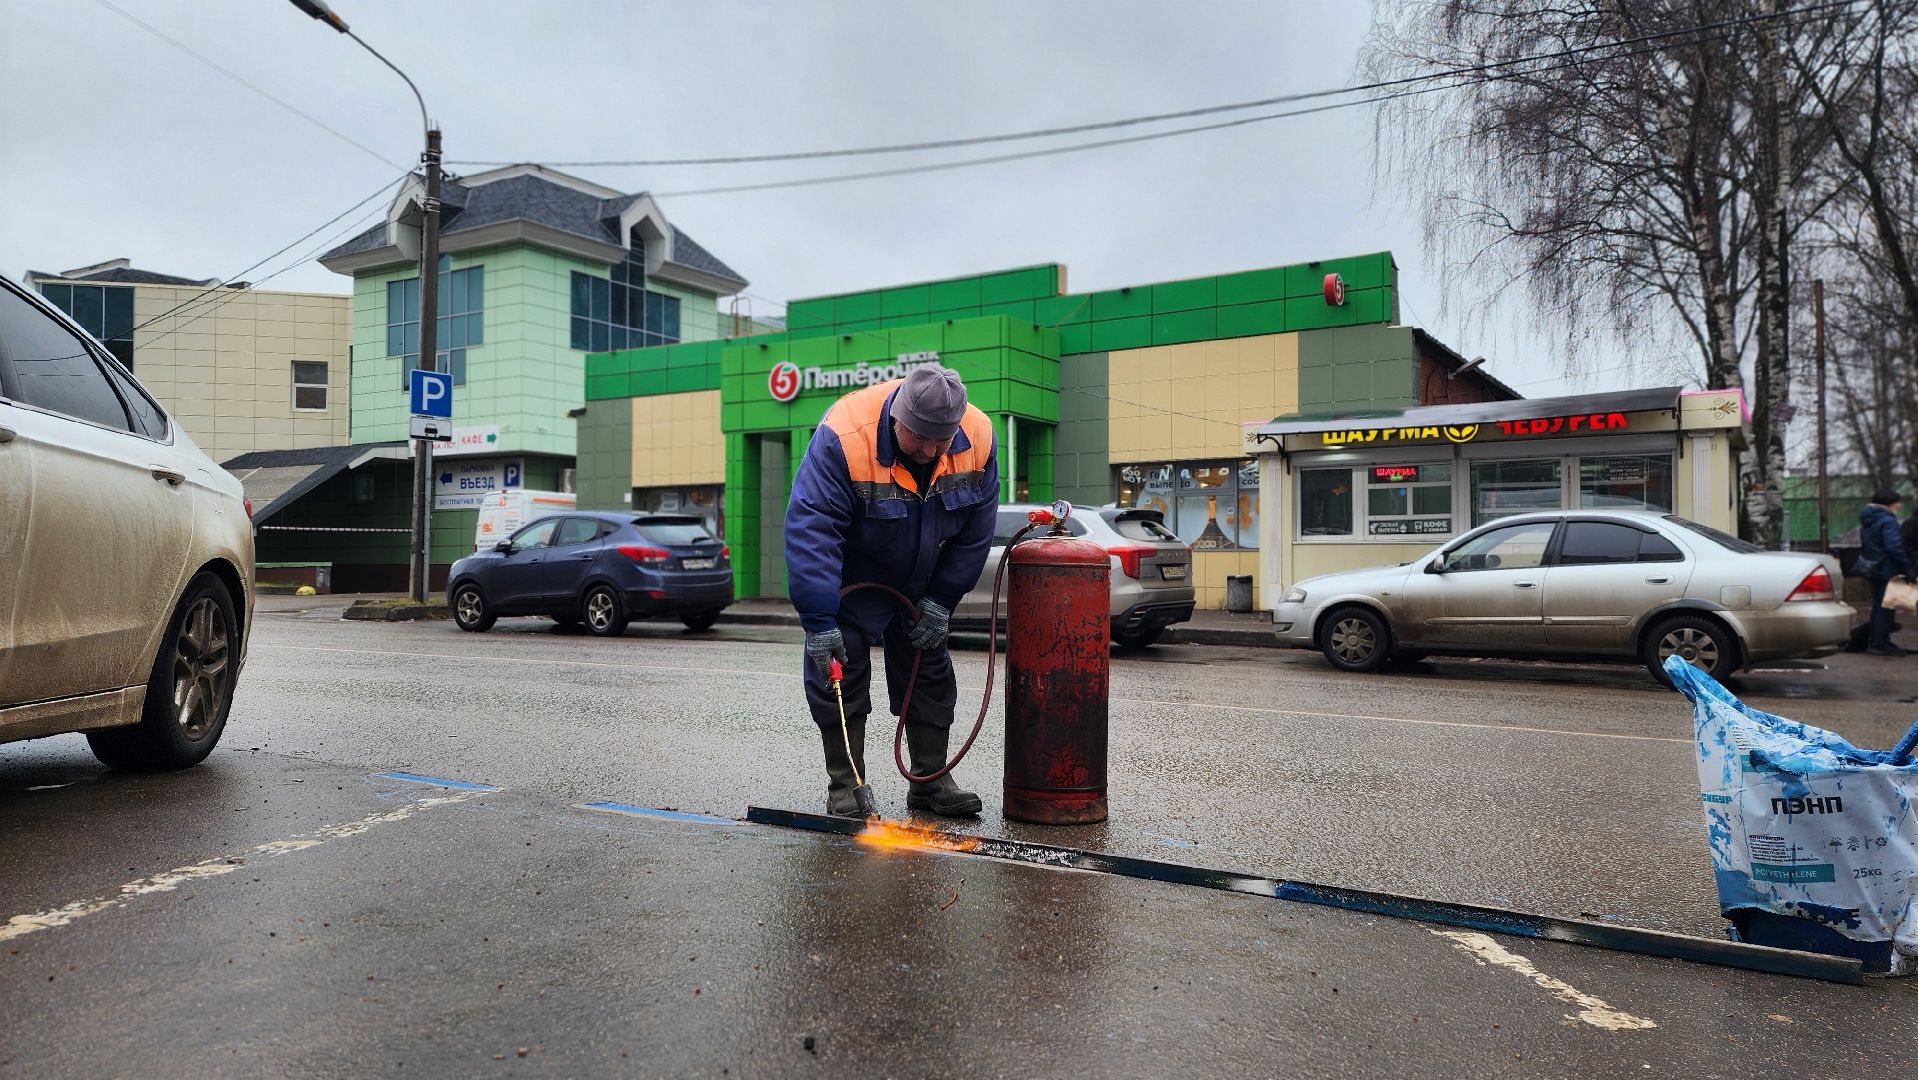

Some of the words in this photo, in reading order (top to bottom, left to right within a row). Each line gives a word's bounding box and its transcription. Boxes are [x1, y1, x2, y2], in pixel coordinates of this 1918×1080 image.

[804, 363, 922, 390] Пятёроч
[422, 375, 445, 411] P
[461, 434, 483, 445] КАФЕ
[460, 463, 495, 473] ПАРКОВКА
[1376, 467, 1417, 476] ШАУРМА
[507, 466, 518, 485] P
[460, 476, 495, 490] ВЪЕЗД
[439, 498, 474, 506] БЕСПЛАТНАЯ
[1423, 520, 1448, 528] КОФЕ
[1701, 793, 1732, 805] СИБУР
[1770, 796, 1843, 815] ПЭНП
